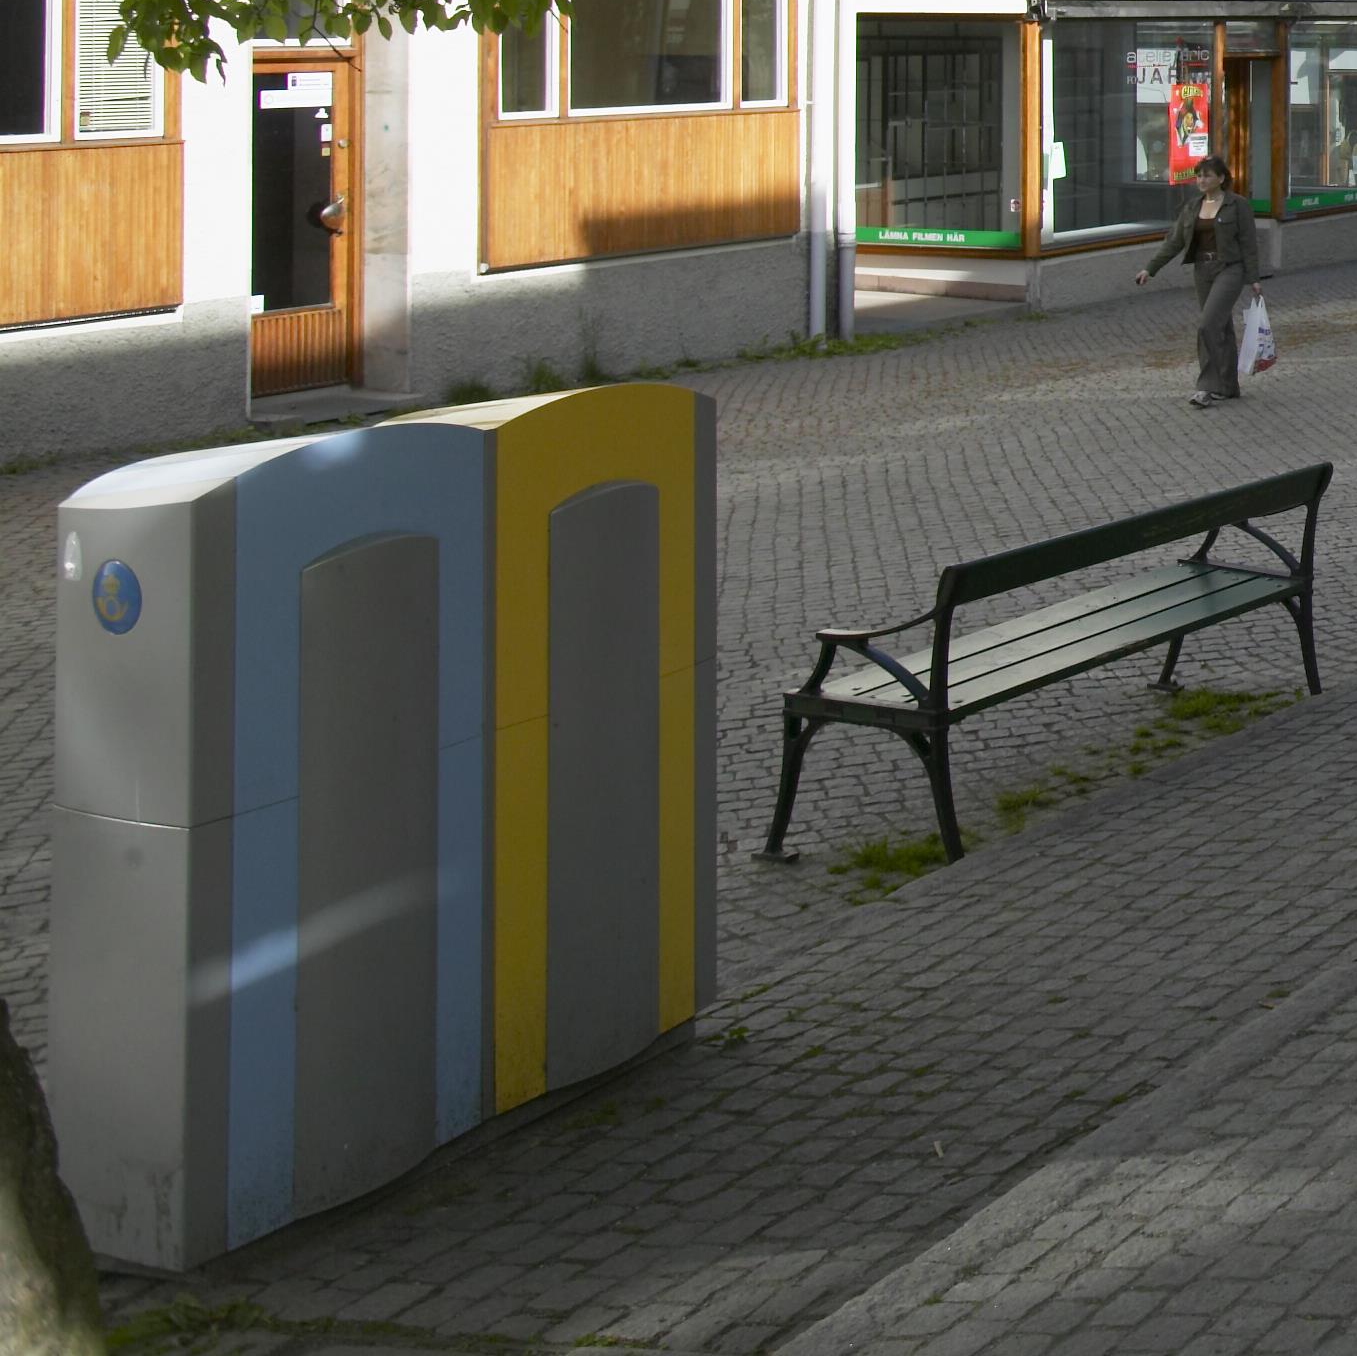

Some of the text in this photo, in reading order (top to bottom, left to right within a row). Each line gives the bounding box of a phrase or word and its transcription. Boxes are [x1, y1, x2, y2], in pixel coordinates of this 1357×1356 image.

[878, 230, 965, 243] LÄMNA FILMEN HÄR
